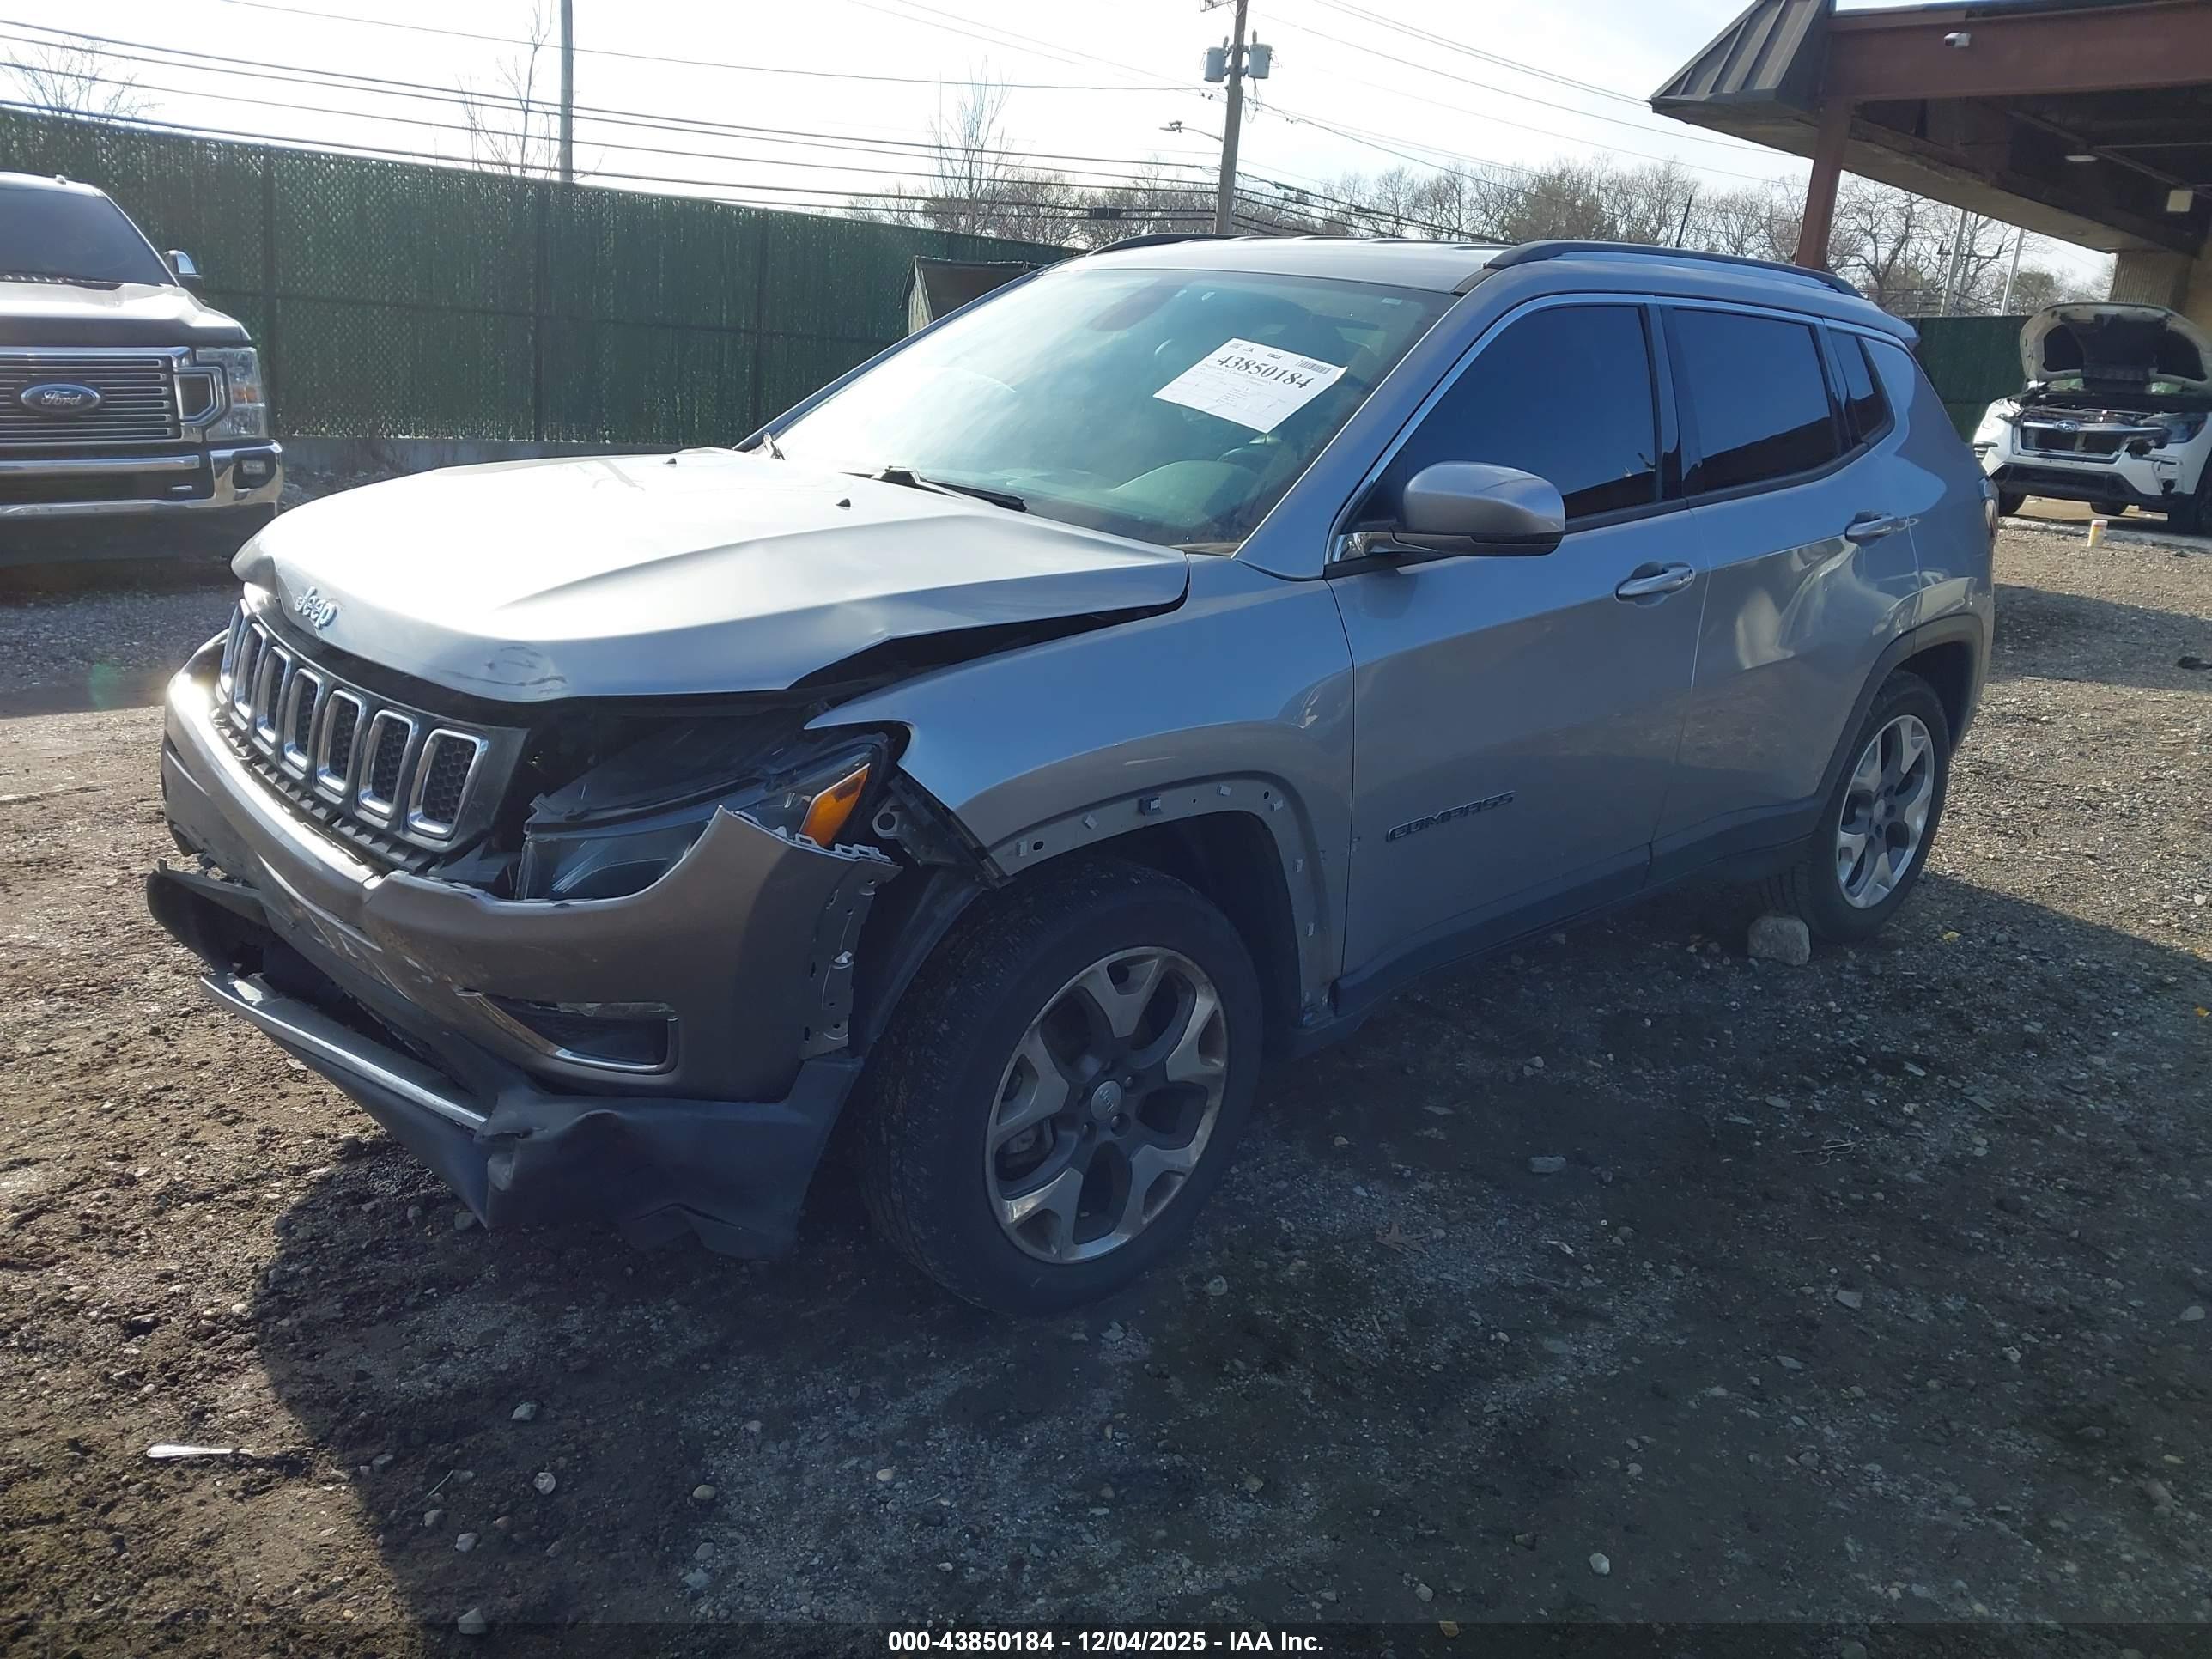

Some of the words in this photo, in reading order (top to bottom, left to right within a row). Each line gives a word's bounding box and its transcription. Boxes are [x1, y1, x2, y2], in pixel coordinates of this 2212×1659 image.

[1217, 355, 1314, 389] 43850184
[41, 390, 82, 406] Ford
[295, 586, 337, 629] Jeep
[1386, 790, 1516, 842] COMPASS
